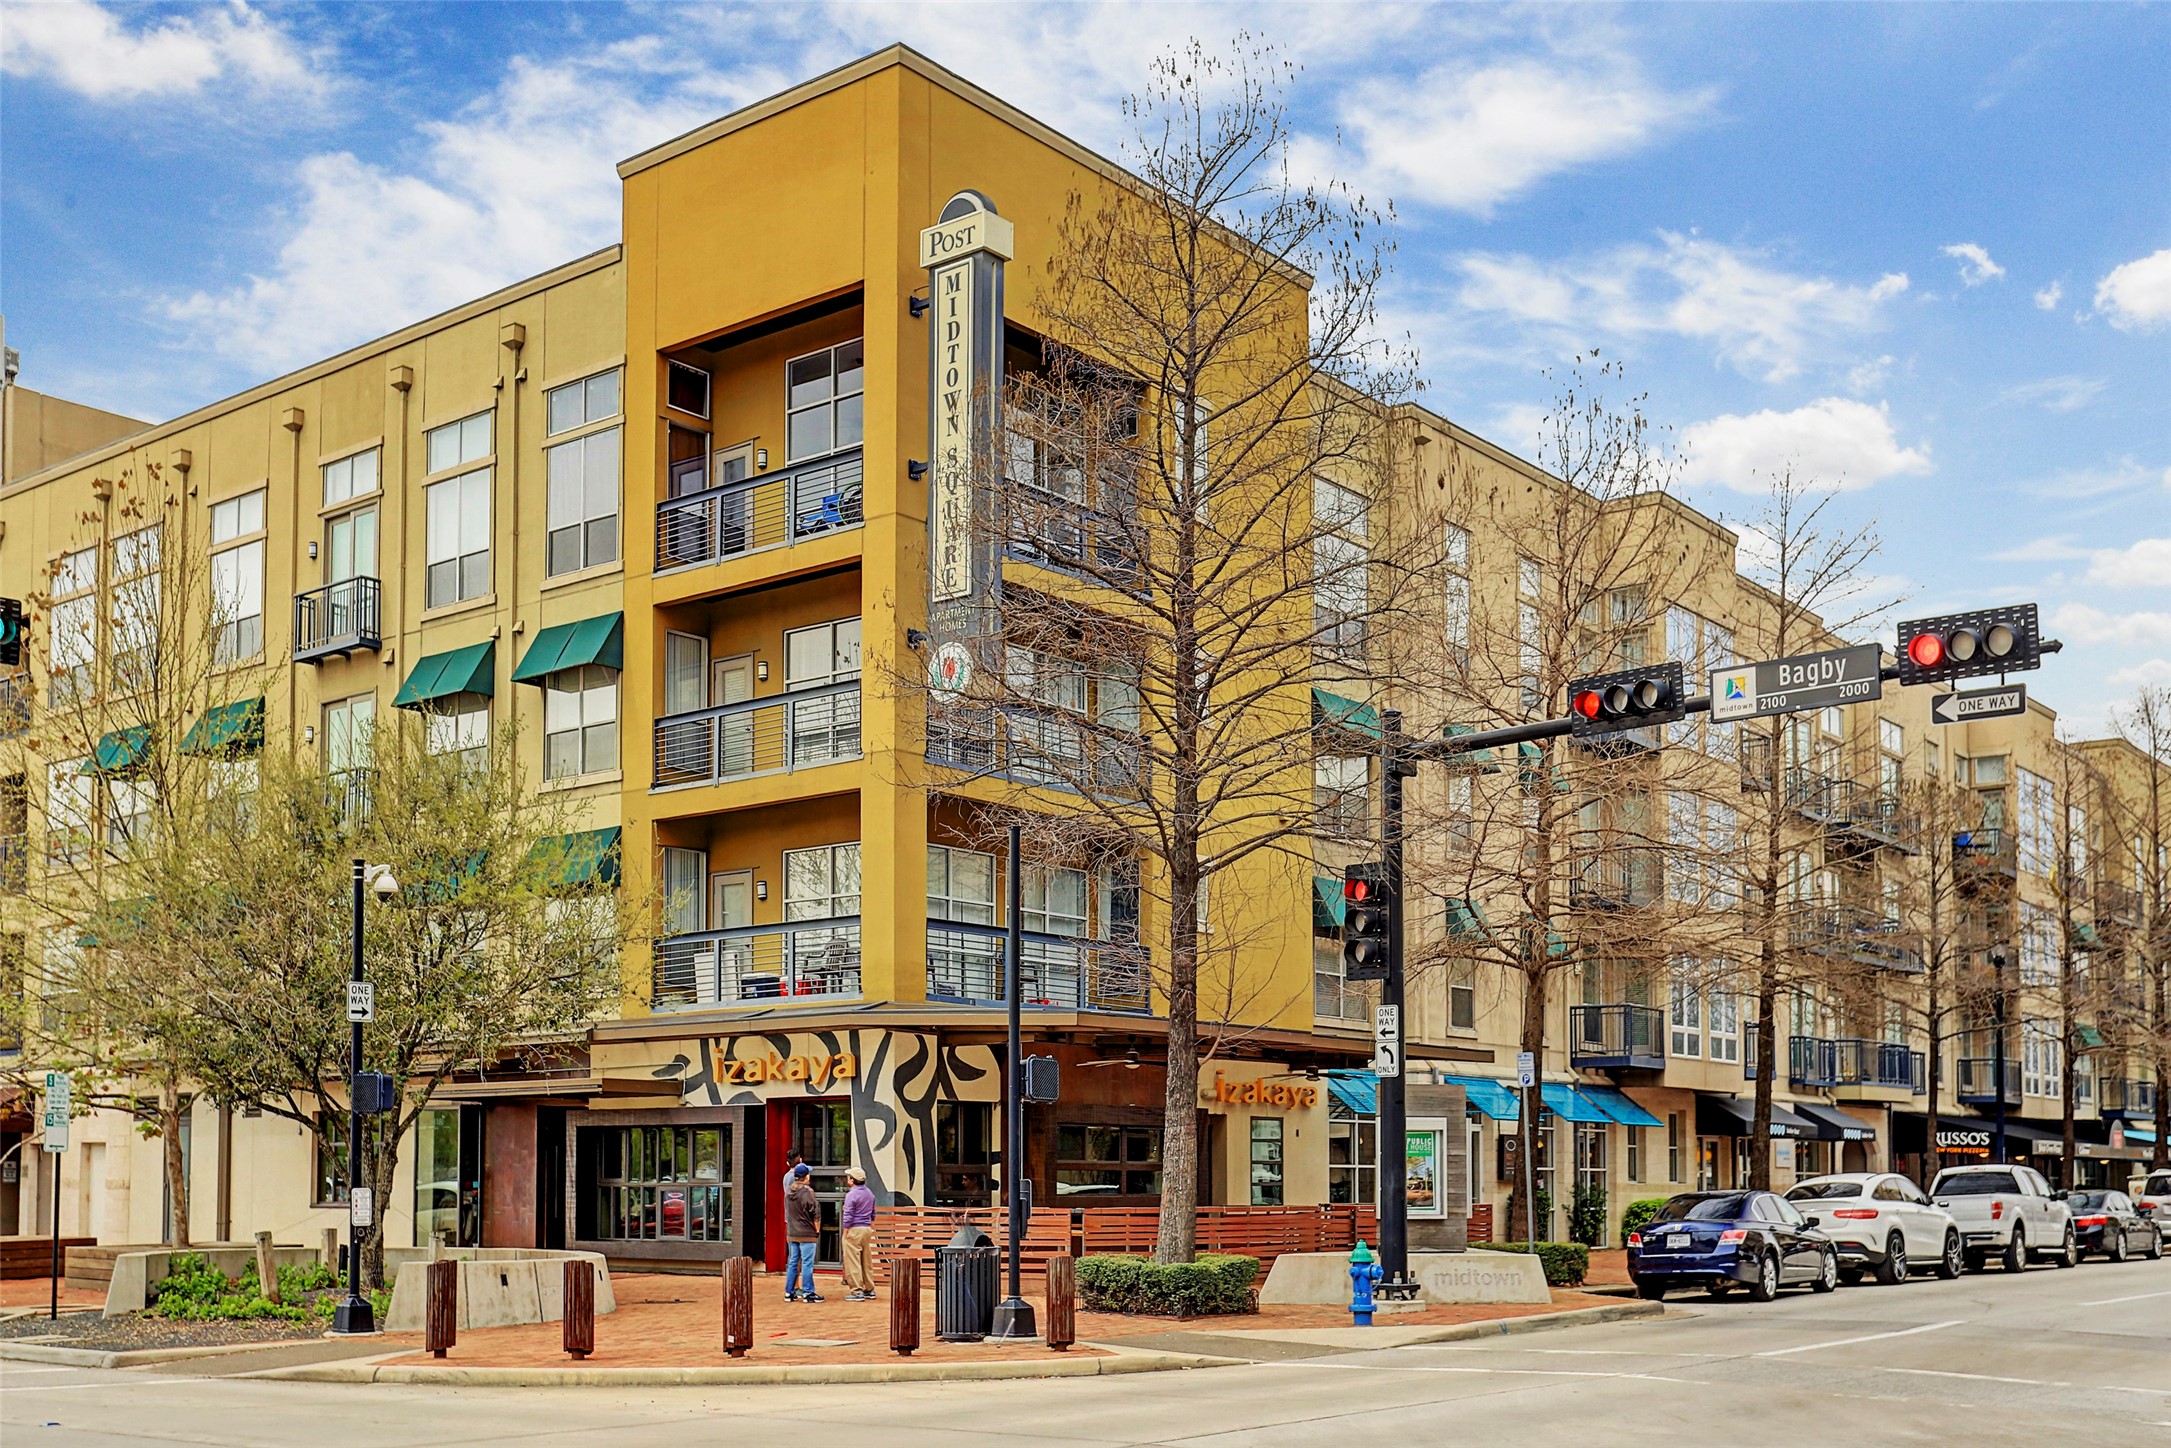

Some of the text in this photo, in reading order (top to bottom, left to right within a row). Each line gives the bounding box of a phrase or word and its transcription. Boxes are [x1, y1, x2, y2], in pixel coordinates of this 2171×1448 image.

[929, 224, 976, 258] POST
[943, 271, 962, 437] MIDTOWN
[931, 604, 975, 623] APARTMENT
[939, 618, 967, 632] HOMES
[1779, 656, 1847, 687] Bagby
[1760, 682, 1870, 710] 2100 2000
[1958, 694, 2016, 713] ONE WAY
[1719, 702, 1754, 714] midtown
[351, 985, 370, 995] ONE
[350, 995, 370, 1005] WAY
[1378, 1008, 1395, 1017] ONE
[1378, 1017, 1395, 1026] WAY
[713, 1047, 856, 1085] izakaya
[1378, 1066, 1396, 1074] ONLY
[1216, 1068, 1318, 1111] izakaya
[1406, 1137, 1432, 1145] PUBLIC
[1434, 1268, 1522, 1286] midtown
